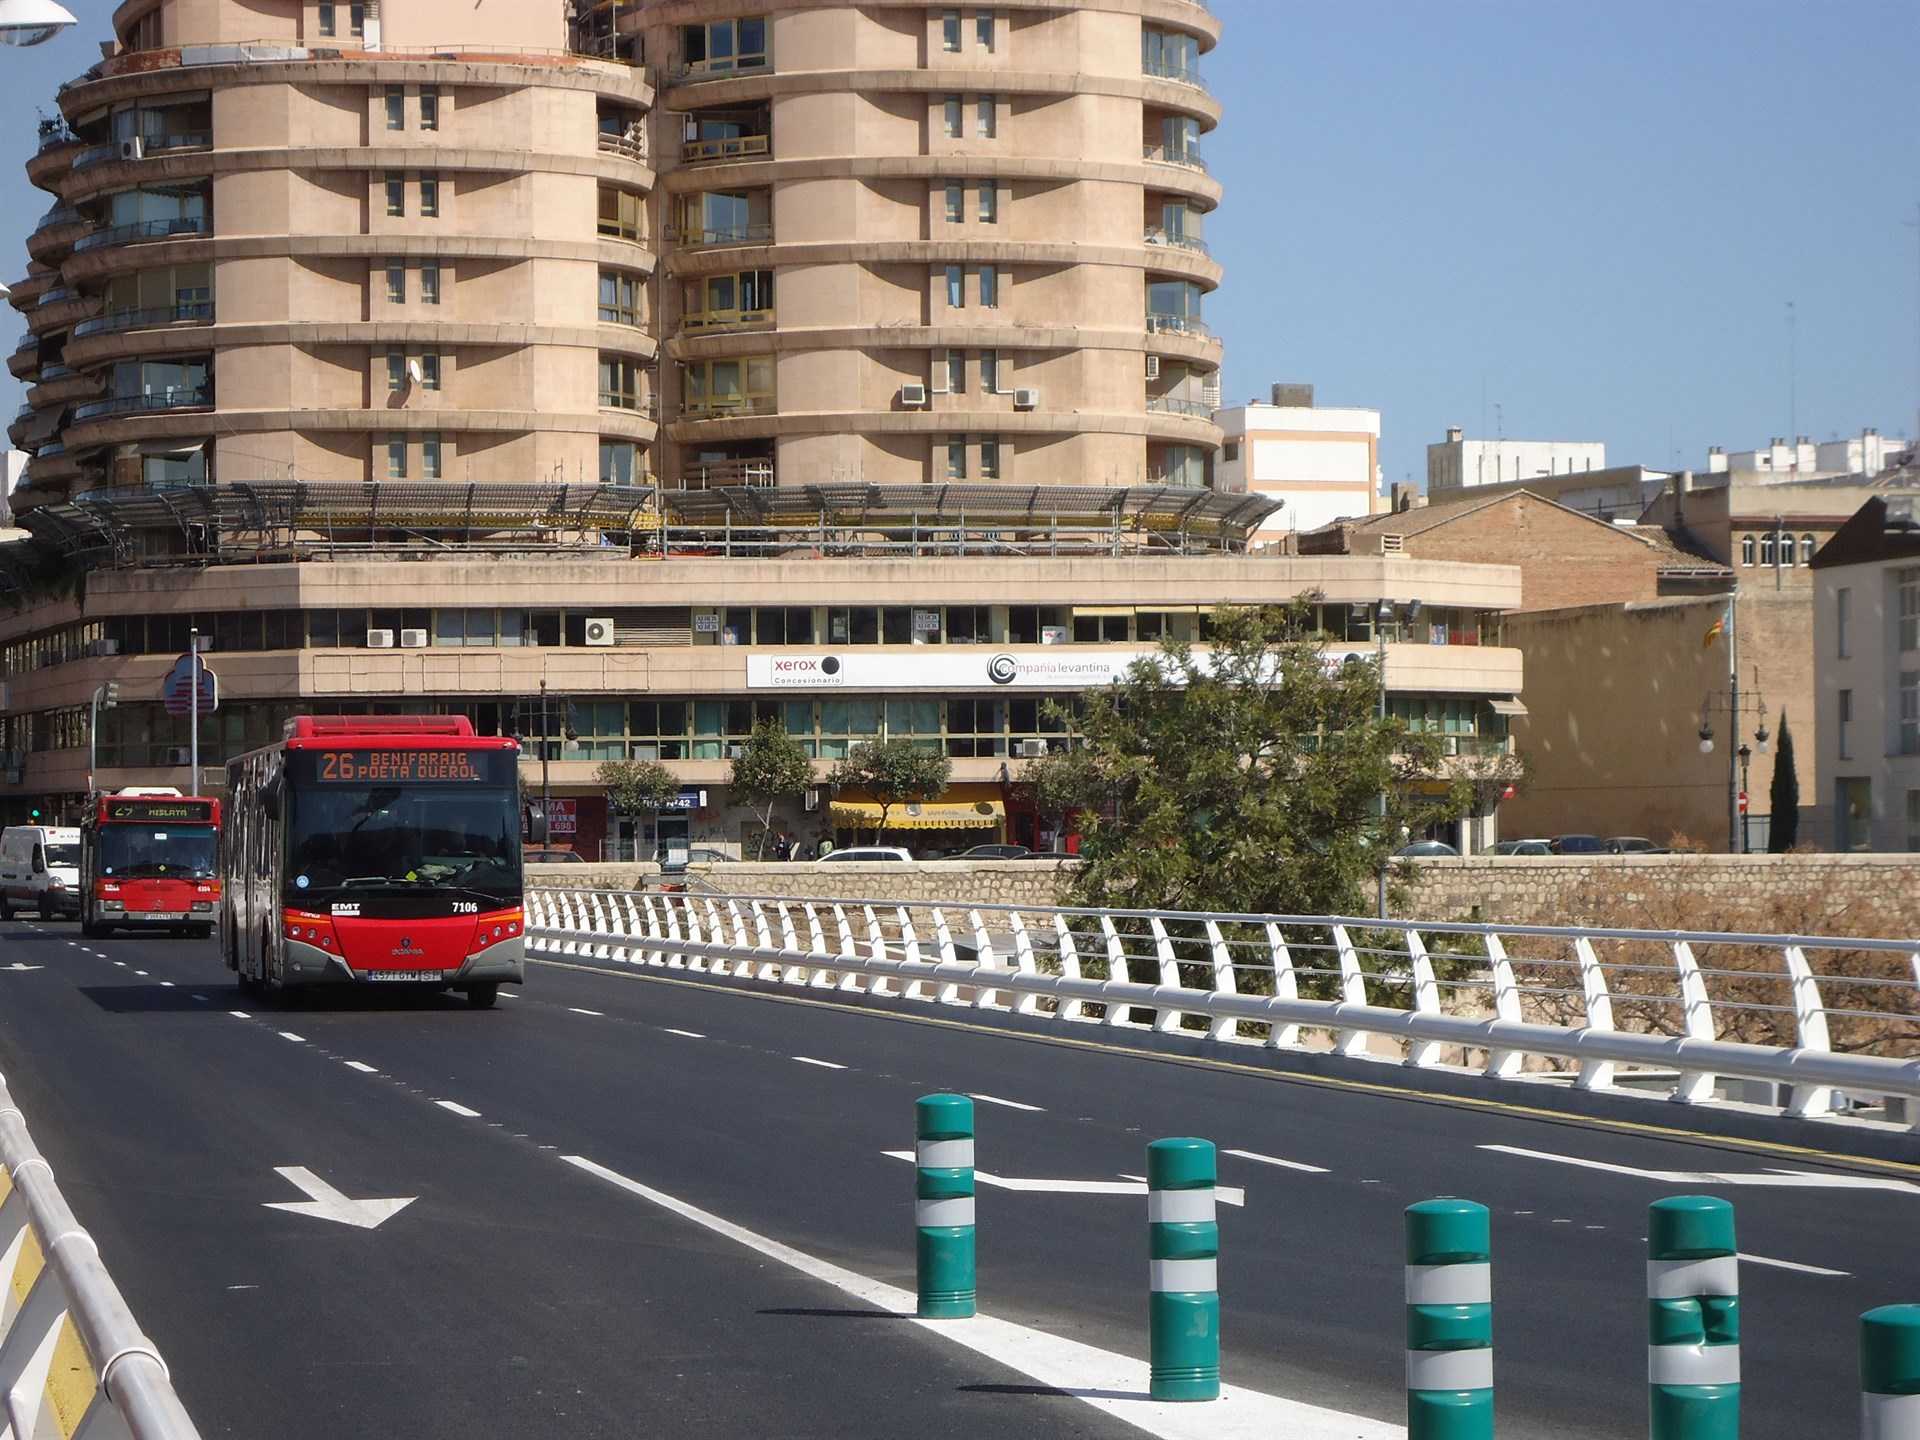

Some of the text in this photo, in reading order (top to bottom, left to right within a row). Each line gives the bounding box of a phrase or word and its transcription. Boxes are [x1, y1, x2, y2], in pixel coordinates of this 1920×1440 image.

[774, 659, 817, 671] xerox
[1058, 663, 1110, 673] levantina
[370, 753, 467, 765] BENIFARAIG
[322, 752, 354, 779] 26
[358, 766, 409, 778] POETA
[331, 903, 361, 911] EMT
[452, 902, 478, 913] 7106
